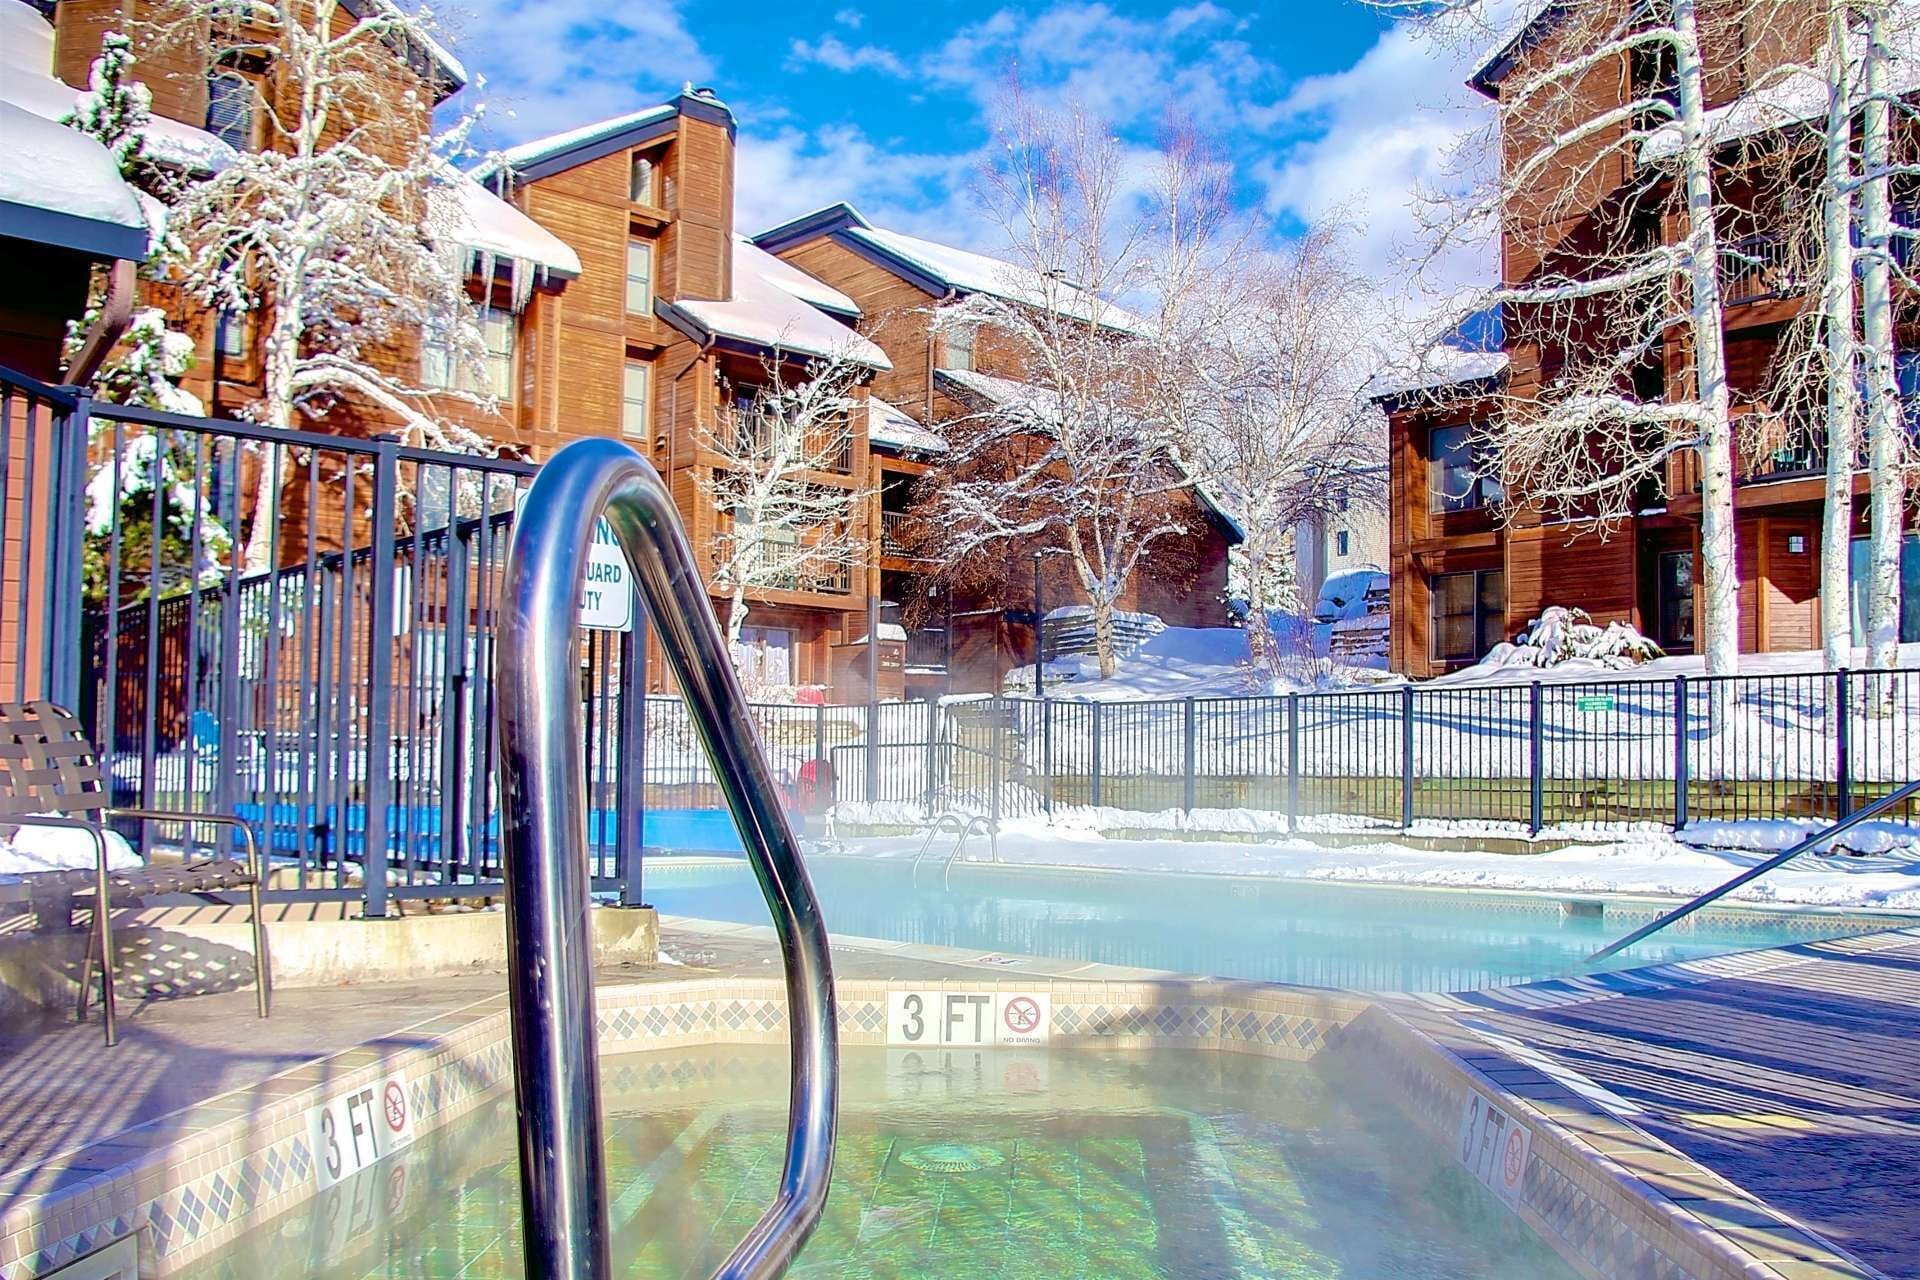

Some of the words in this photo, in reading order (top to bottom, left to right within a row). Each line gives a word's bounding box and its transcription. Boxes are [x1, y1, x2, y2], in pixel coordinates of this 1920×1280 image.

[584, 561, 621, 583] UARD
[902, 993, 925, 1041] 3
[945, 994, 990, 1042] FT
[321, 1107, 342, 1180] 3
[347, 1088, 378, 1168] FT
[1462, 1095, 1479, 1162] 3
[1476, 1106, 1506, 1185] FT
